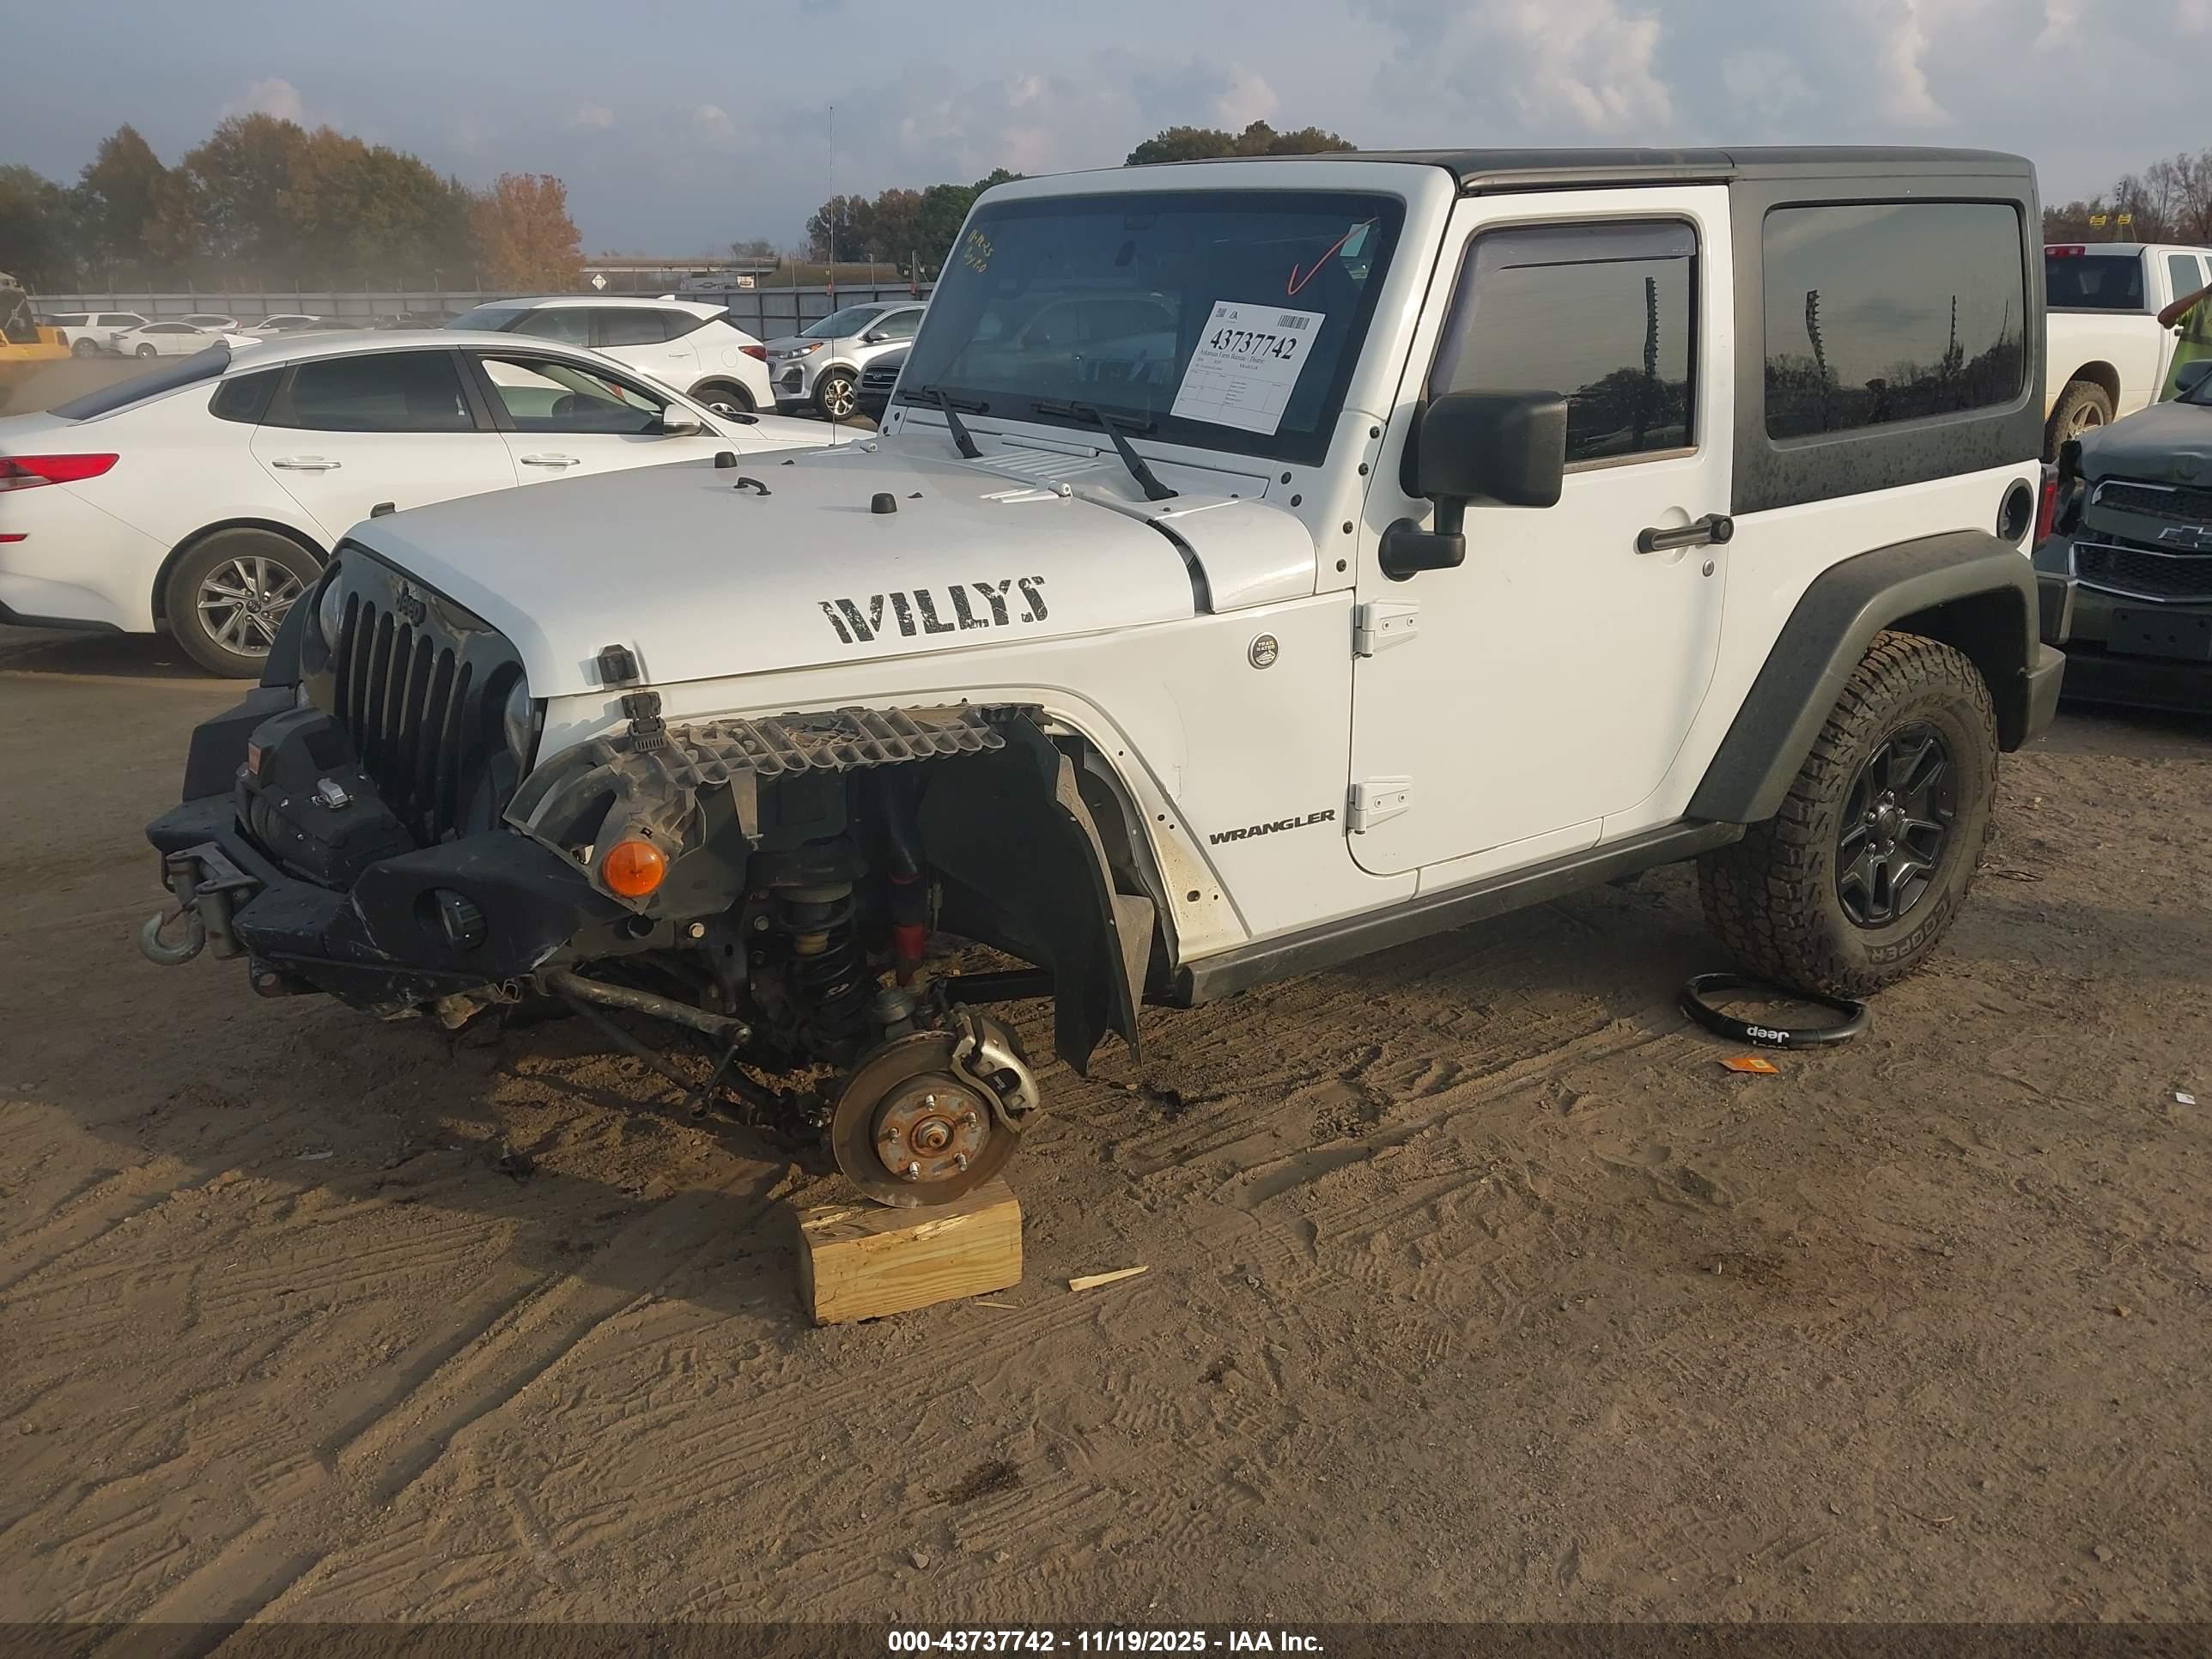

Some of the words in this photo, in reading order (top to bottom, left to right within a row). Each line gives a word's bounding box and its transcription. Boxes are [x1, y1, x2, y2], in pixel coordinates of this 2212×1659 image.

[1210, 328, 1297, 360] 43737742
[817, 575, 1048, 644] WILLYS
[1209, 809, 1336, 845] WRANGLER
[1871, 899, 1948, 962] COOPER
[1747, 1025, 1790, 1044] Jeep
